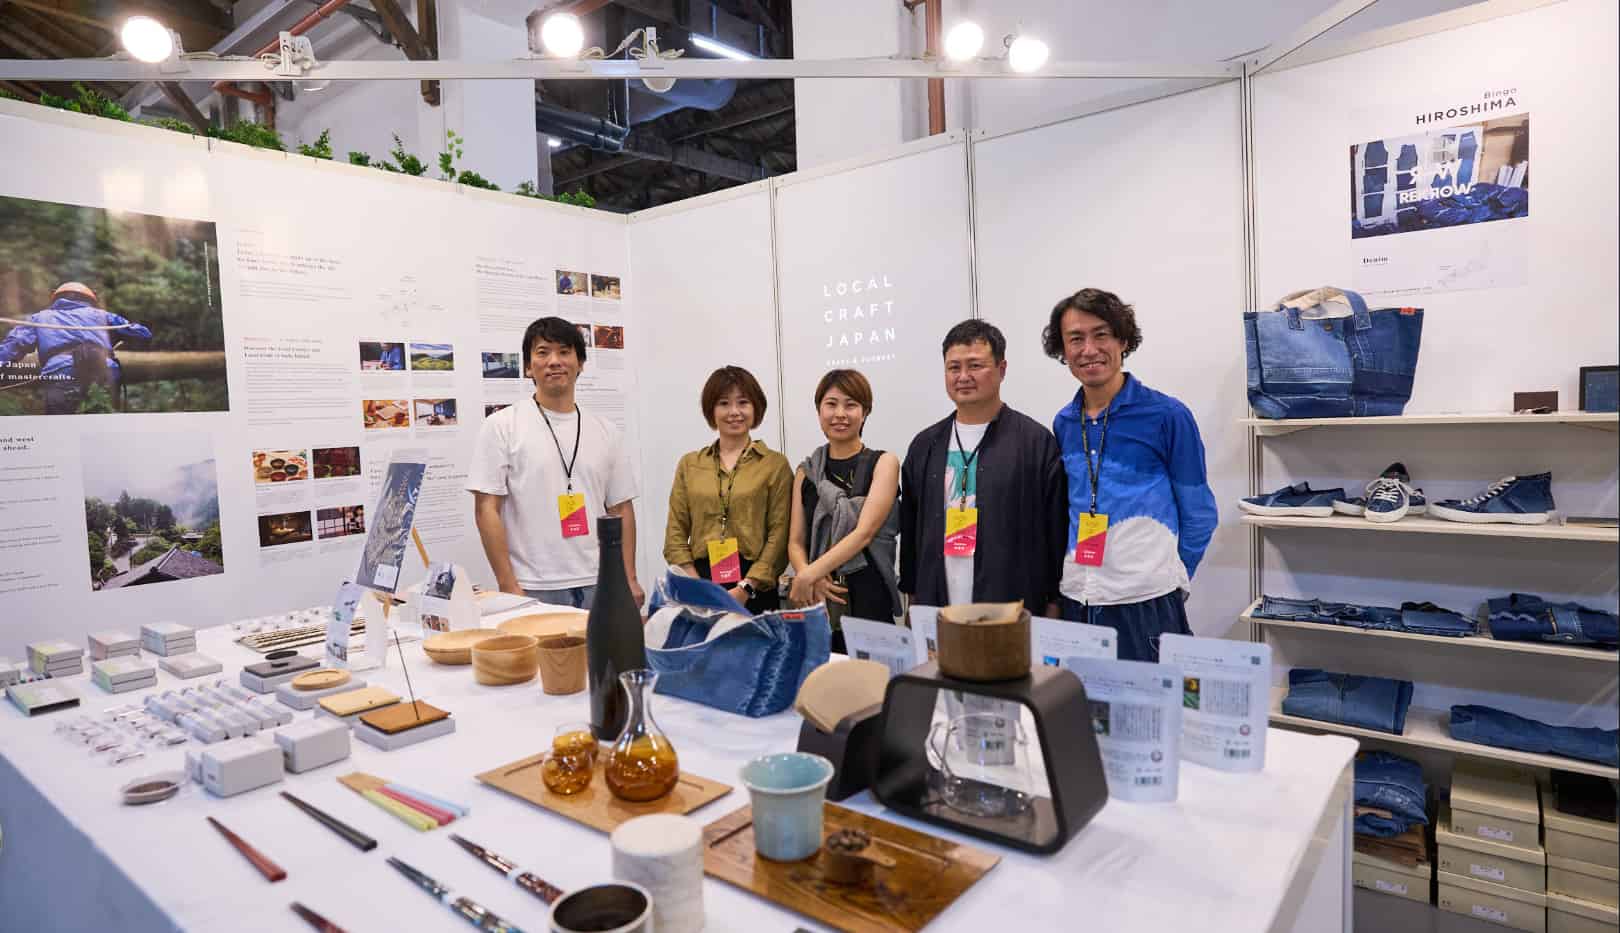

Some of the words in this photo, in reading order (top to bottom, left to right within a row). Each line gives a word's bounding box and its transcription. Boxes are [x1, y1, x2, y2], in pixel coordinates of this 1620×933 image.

[1416, 97, 1517, 125] HIROSHIMA
[823, 274, 893, 297] LOCAL
[823, 300, 894, 323] CRAFT
[825, 327, 896, 348] JAPAN
[5, 361, 37, 369] Japan
